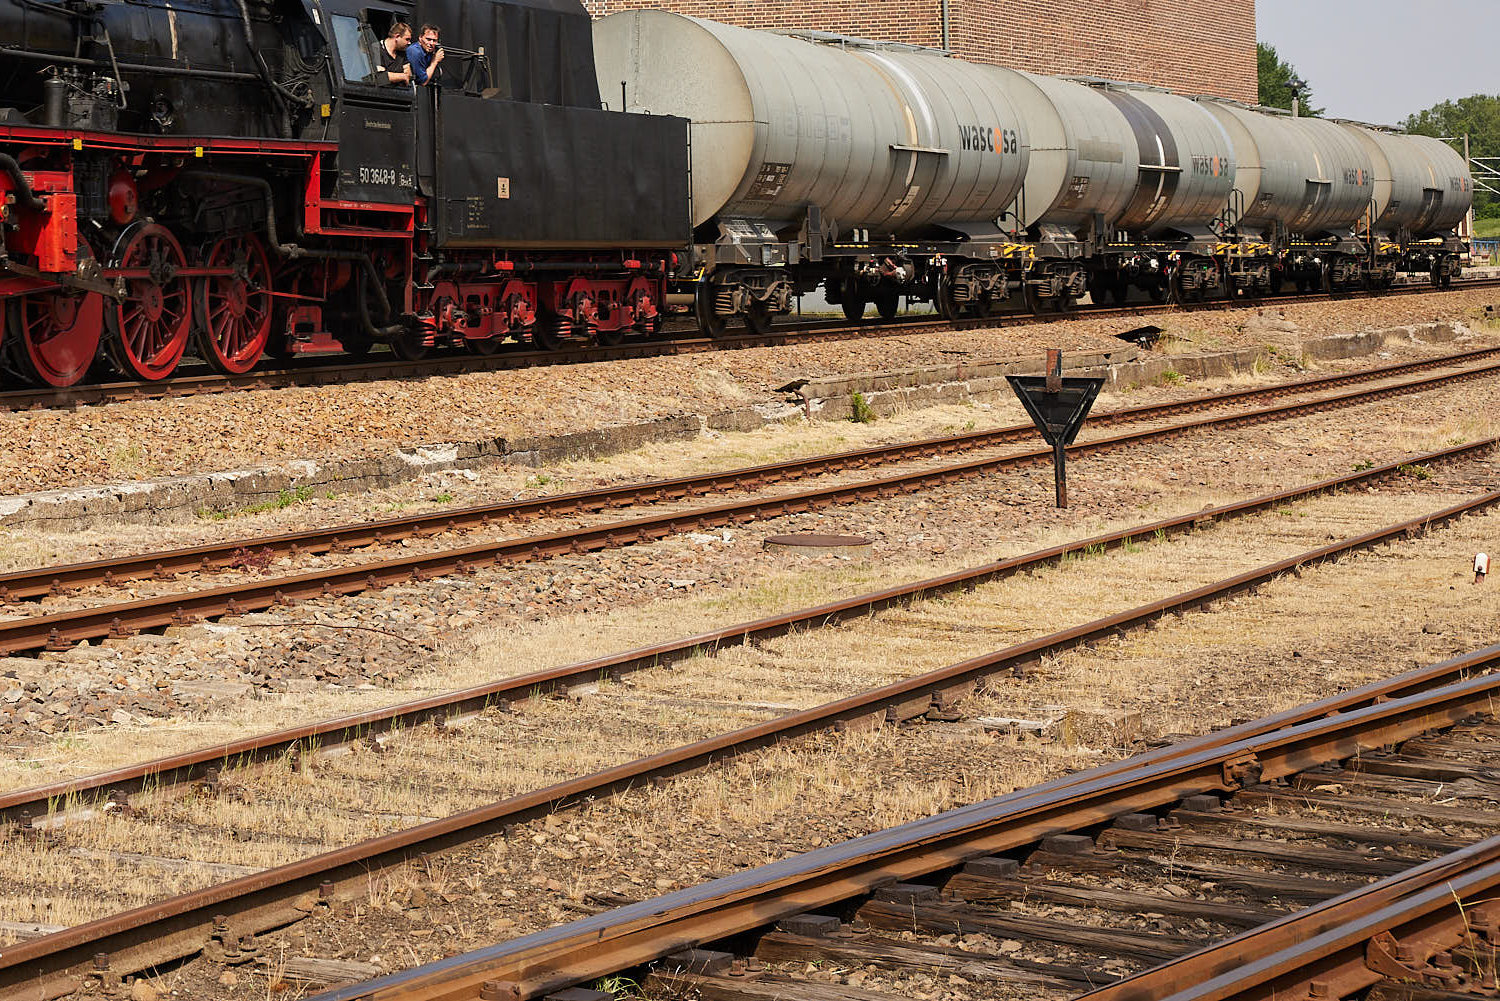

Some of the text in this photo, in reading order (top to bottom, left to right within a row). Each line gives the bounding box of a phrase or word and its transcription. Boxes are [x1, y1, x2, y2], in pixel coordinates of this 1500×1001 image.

[958, 125, 1017, 155] wascosa
[360, 168, 370, 183] 50
[370, 168, 396, 185] 3648-8
